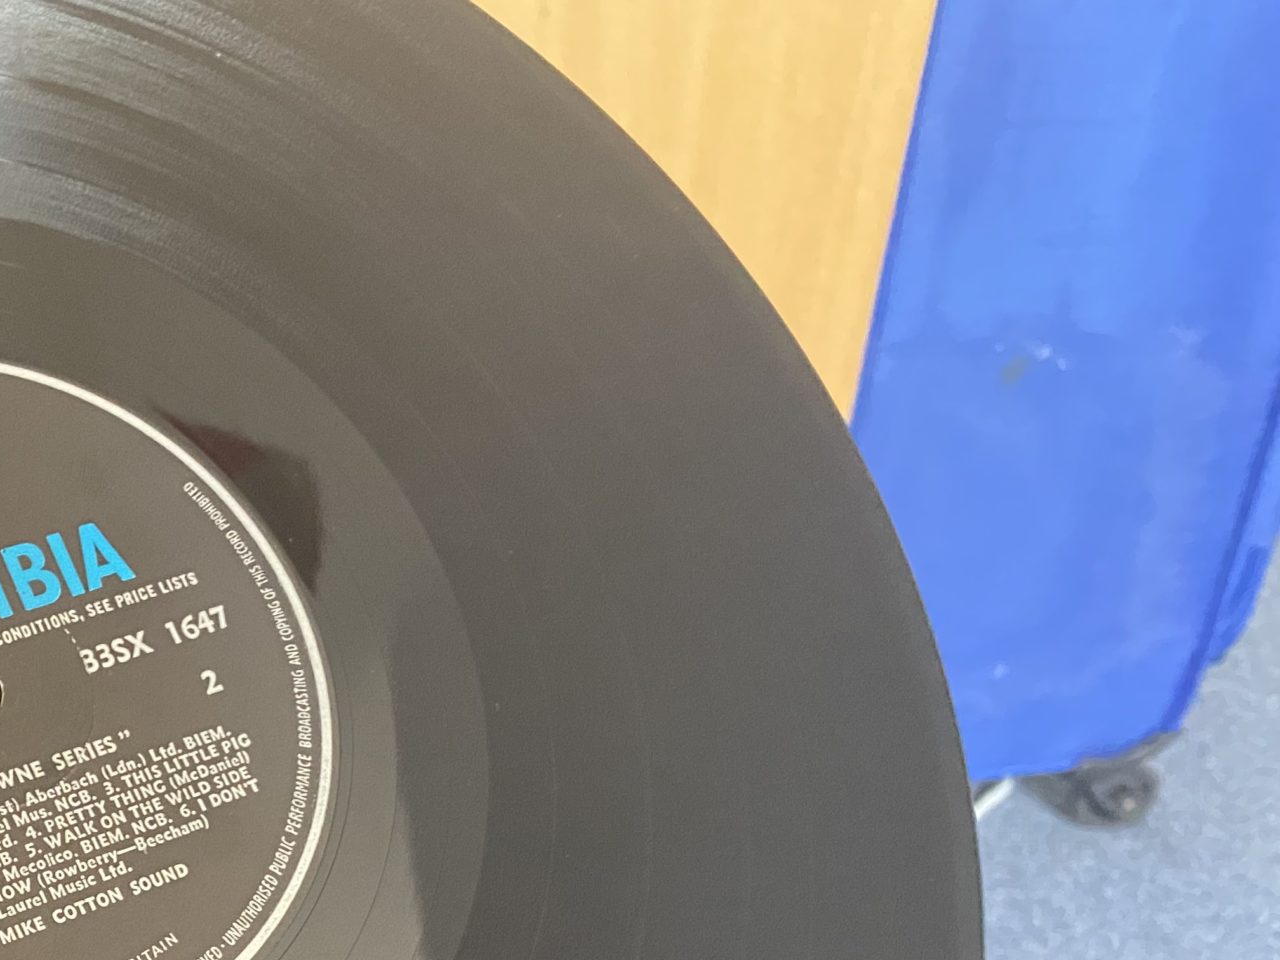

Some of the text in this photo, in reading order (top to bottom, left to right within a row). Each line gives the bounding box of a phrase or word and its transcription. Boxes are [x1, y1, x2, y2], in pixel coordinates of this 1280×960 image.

[183, 481, 231, 531] PROHIBITED
[225, 529, 256, 566] RECORD
[85, 600, 114, 618] SEE
[116, 583, 157, 609] PRICE
[158, 572, 199, 593] LISTS
[248, 564, 269, 587] THIS
[259, 587, 276, 600] OF
[165, 605, 228, 644] 1647
[267, 600, 295, 641] COPYING
[284, 643, 304, 666] AND
[200, 669, 225, 696] 2
[290, 669, 313, 749] BROADCASTING
[12, 805, 52, 828] Mus.
[55, 789, 97, 813] NCB.
[103, 781, 120, 796] 3.
[120, 764, 162, 789] THIS
[163, 744, 218, 775] LITTLE
[221, 733, 252, 754] PIG
[24, 771, 99, 807] Aberbach
[101, 753, 147, 780] (Ldn.)
[148, 742, 183, 763] Ltd.
[182, 725, 232, 750] BIEM.
[24, 826, 42, 839] 4.
[44, 799, 106, 833] PRETTY
[110, 779, 167, 809] THING
[169, 750, 251, 789] (McDaniel)
[24, 842, 42, 858] 5.
[43, 820, 98, 850] WALK
[100, 809, 128, 830] ON
[128, 796, 164, 819] THE
[164, 780, 211, 807] WILD
[215, 765, 252, 789] SIDE
[285, 753, 312, 836] PERFORMANCE
[2, 849, 78, 883] Mecolico.
[80, 828, 130, 855] BIEM.
[131, 811, 173, 835] NCB.
[179, 804, 196, 818] 6.
[198, 797, 207, 812] I
[208, 778, 260, 809] DON'T
[268, 835, 297, 876] PUBLIC
[49, 873, 97, 901] Music
[98, 860, 134, 882] Ltd.
[52, 886, 124, 924] COTTON
[130, 863, 189, 896] SOUND
[222, 874, 279, 946] UNAUTHORISED
